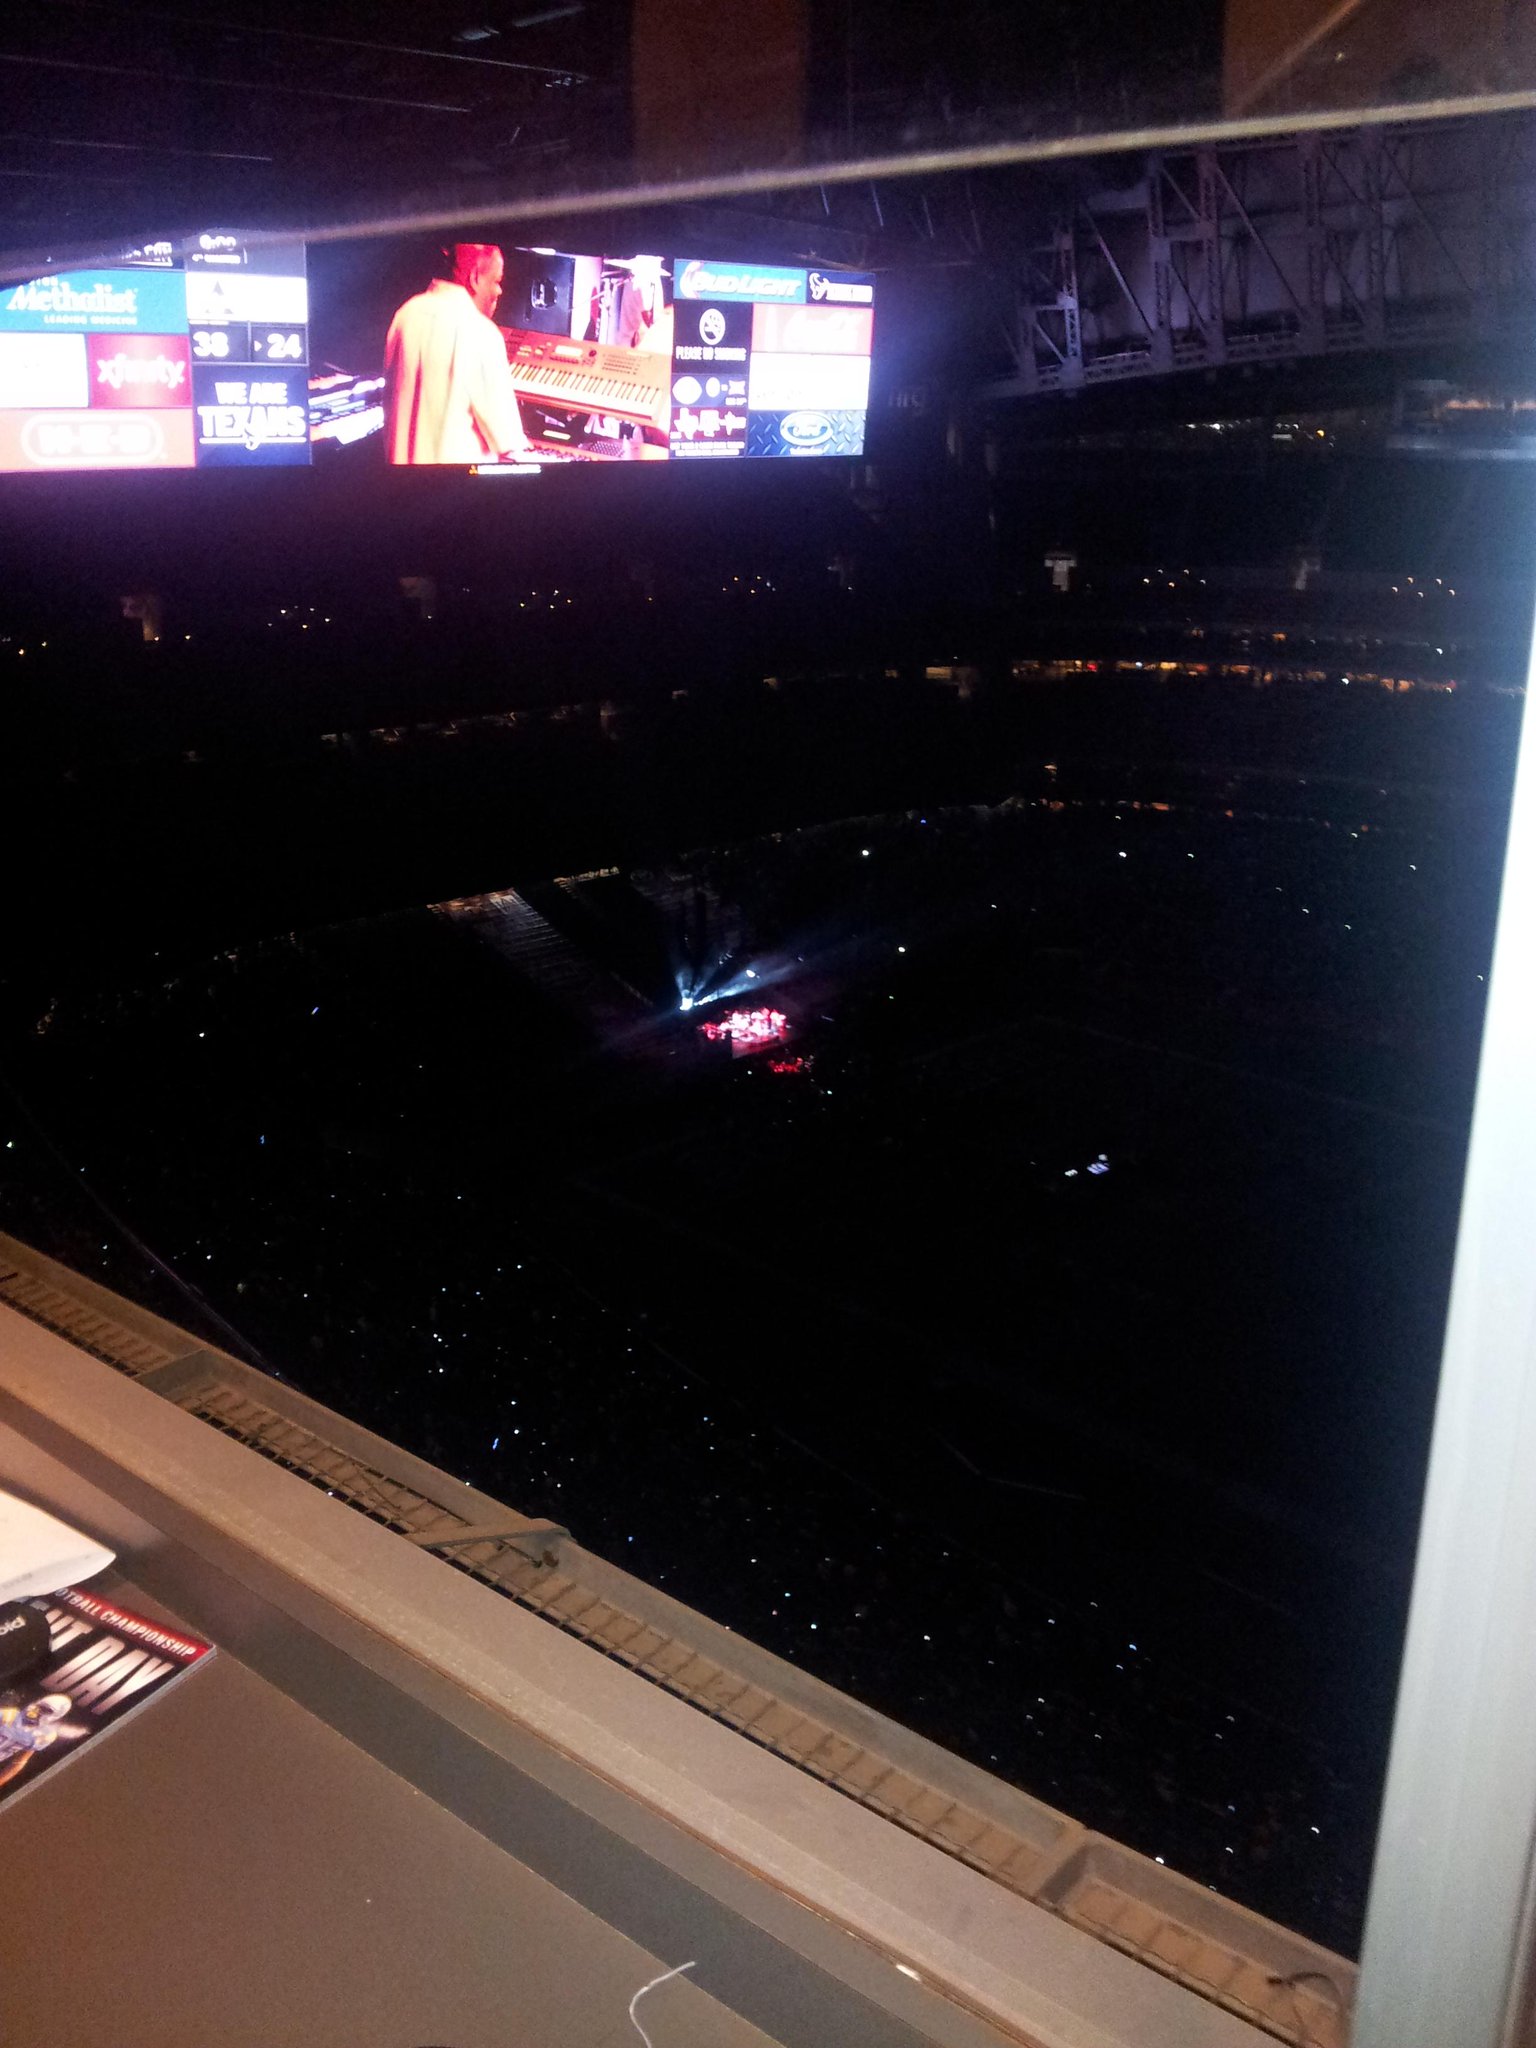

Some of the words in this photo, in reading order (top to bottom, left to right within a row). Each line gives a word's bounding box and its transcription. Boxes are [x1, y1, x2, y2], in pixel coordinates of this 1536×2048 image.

[5, 281, 138, 314] Methodist
[192, 331, 230, 357] 38
[266, 333, 303, 359] 24
[214, 382, 248, 404] WE
[249, 382, 288, 404] ARE
[197, 406, 306, 446] TEXANS
[55, 1587, 102, 1617] OTBALL
[99, 1607, 197, 1658] CHAMPIONSHIP
[40, 1635, 175, 1716] DAY
